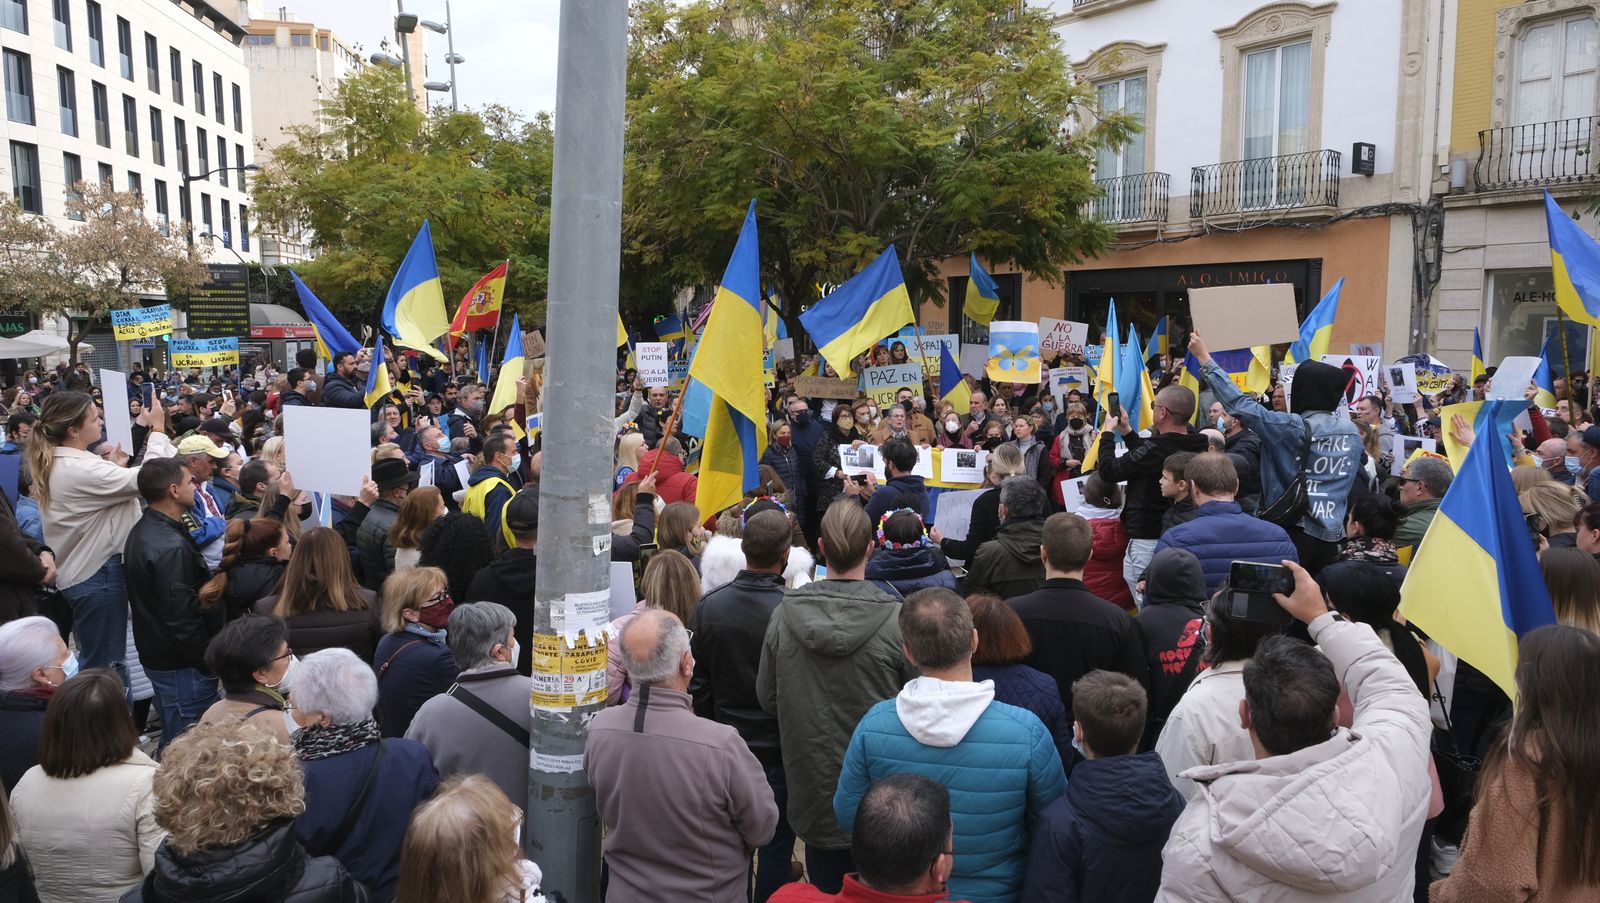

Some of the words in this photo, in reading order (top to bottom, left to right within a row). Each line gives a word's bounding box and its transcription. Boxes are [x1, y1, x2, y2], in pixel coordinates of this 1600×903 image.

[1053, 322, 1073, 334] NO
[1045, 332, 1054, 341] A
[1058, 334, 1071, 342] LA
[1041, 340, 1084, 354] GUERRA
[869, 369, 898, 386] PAZ
[902, 372, 917, 383] EN
